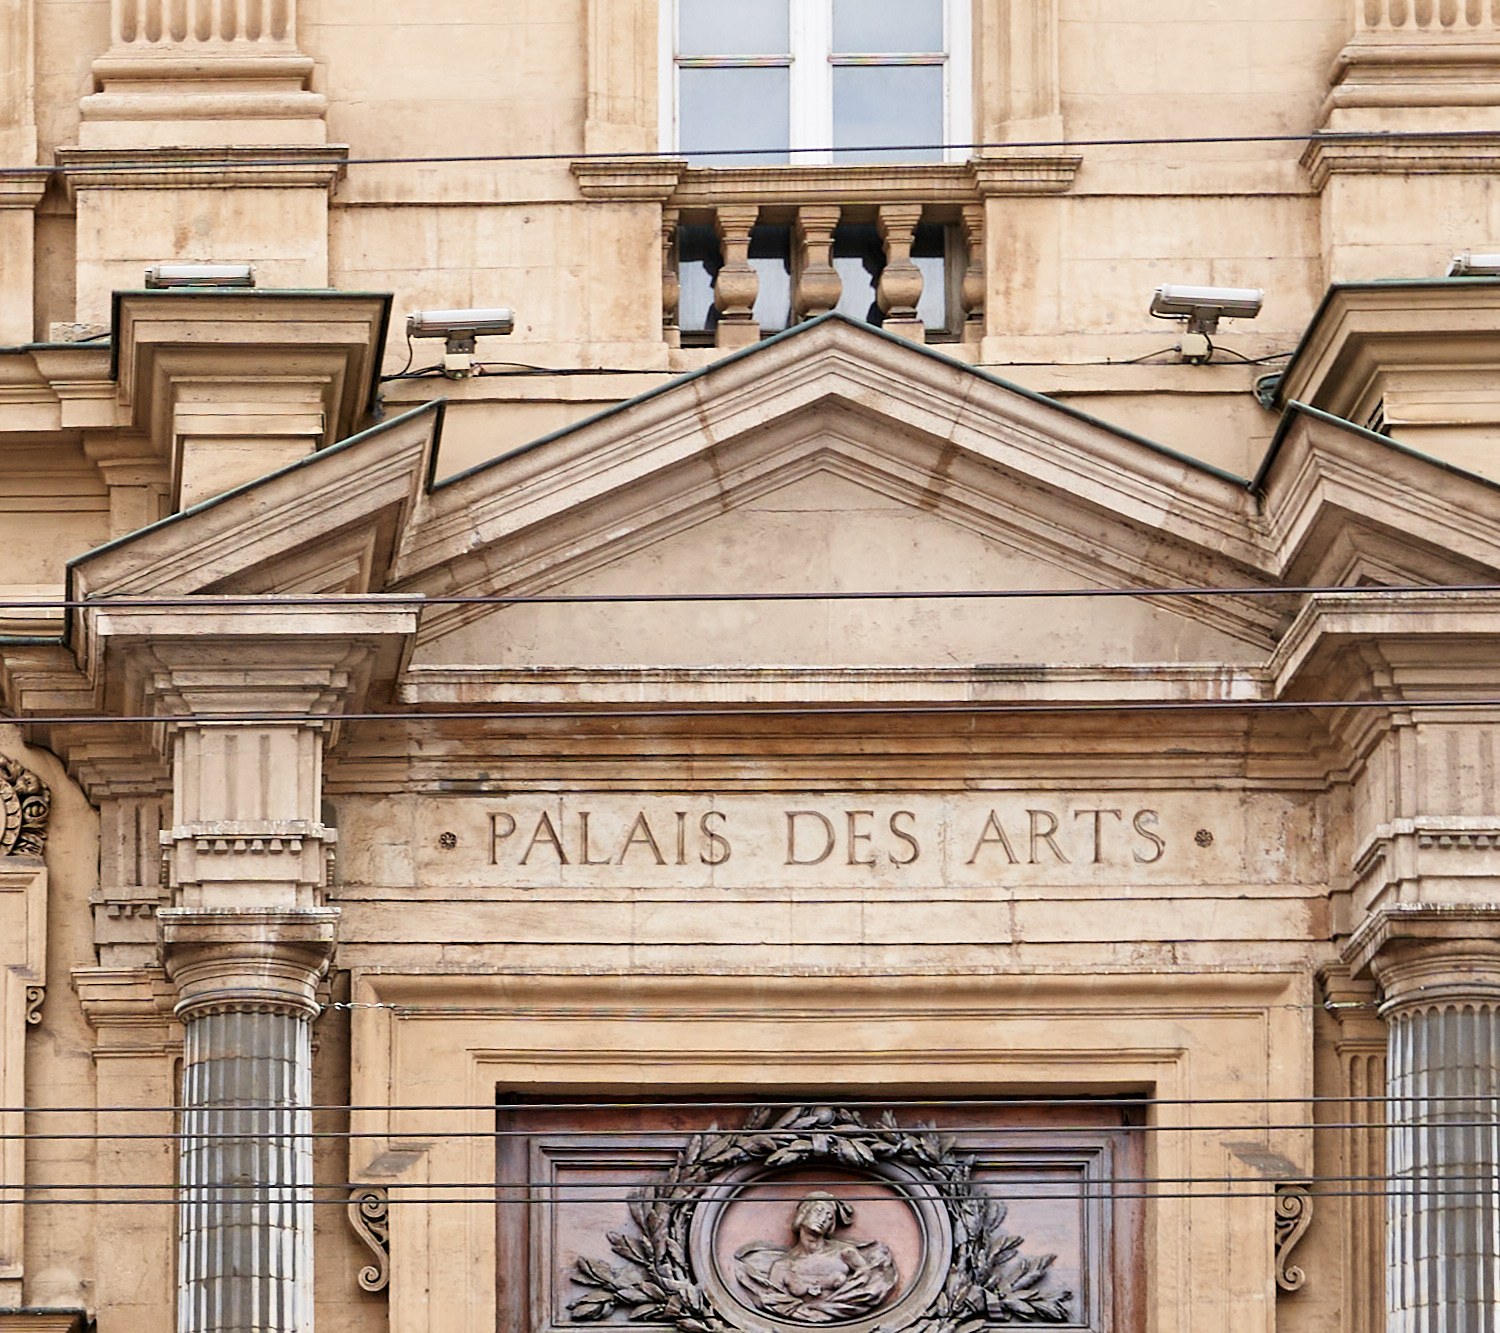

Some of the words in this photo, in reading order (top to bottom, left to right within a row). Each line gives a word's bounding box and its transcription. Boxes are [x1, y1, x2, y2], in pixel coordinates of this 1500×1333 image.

[488, 809, 732, 866] PALAIS
[783, 809, 921, 866] DES
[965, 808, 1167, 866] ARTS
